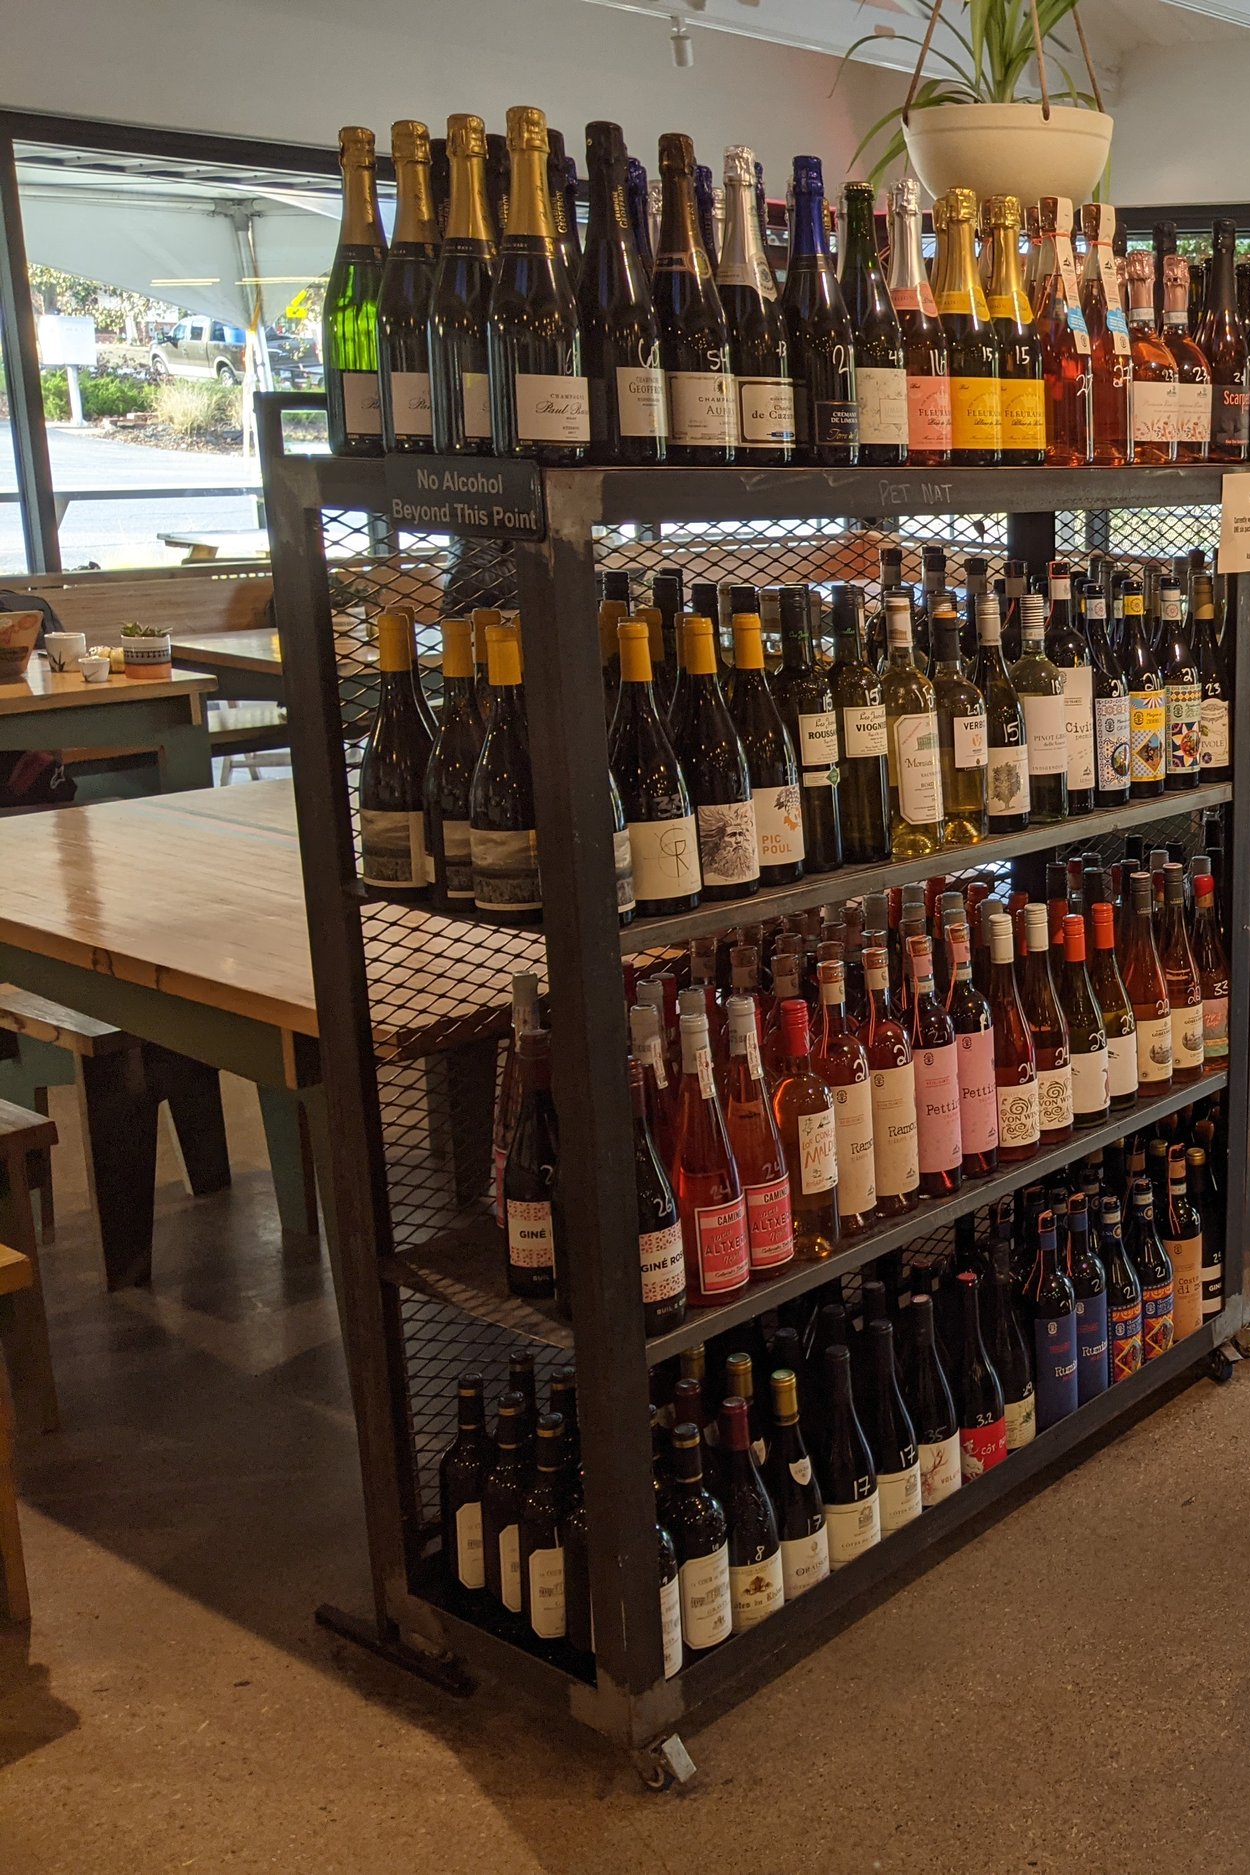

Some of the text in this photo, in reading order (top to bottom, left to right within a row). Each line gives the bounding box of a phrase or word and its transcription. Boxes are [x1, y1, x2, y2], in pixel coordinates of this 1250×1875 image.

[982, 346, 993, 363] 15
[1016, 345, 1029, 364] 15
[535, 400, 569, 415] Paul
[751, 410, 765, 419] de
[416, 468, 503, 494] No Alcohol
[878, 479, 953, 506] PET NAT
[391, 498, 537, 530] Beyond This Point
[865, 687, 880, 706] 15
[1205, 682, 1221, 696] 23
[1003, 720, 1020, 744] 15
[761, 834, 782, 845] PIC
[762, 844, 792, 855] POUL
[1088, 1029, 1107, 1052] 28
[1039, 1099, 1058, 1108] VON
[1000, 1115, 1022, 1124] VON
[652, 1194, 673, 1218] 26
[519, 1227, 547, 1240] GINÉ
[640, 1257, 669, 1274] GINÉ
[899, 1443, 916, 1469] 17
[853, 1475, 871, 1501] 17
[807, 1513, 822, 1536] 17
